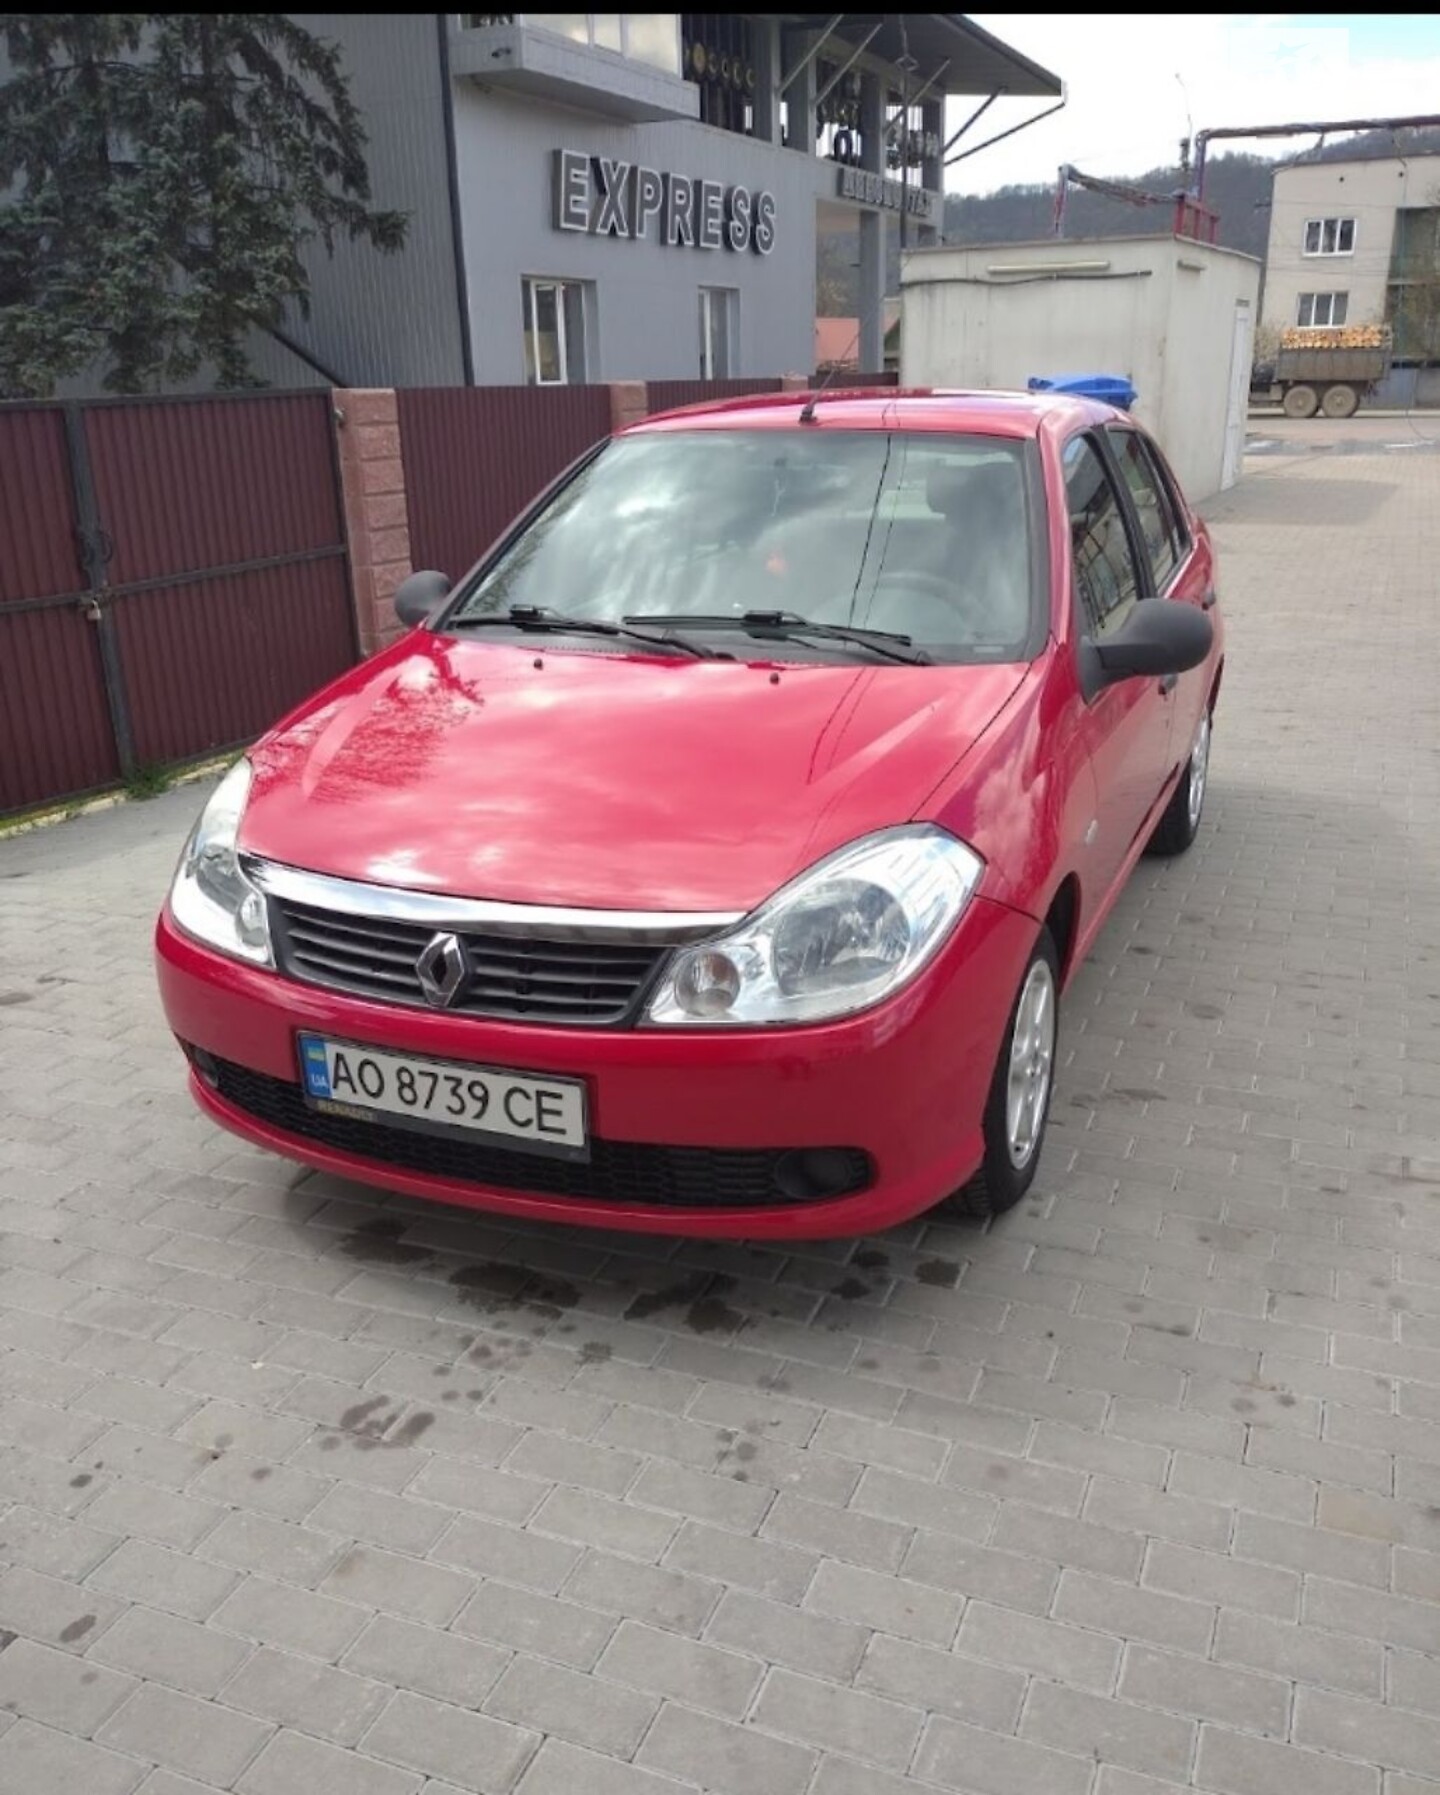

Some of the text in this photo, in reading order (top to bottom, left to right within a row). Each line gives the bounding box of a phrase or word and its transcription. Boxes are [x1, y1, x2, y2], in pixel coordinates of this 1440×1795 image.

[554, 148, 776, 255] EXPRESS
[332, 1052, 567, 1135] AO 8739 CE
